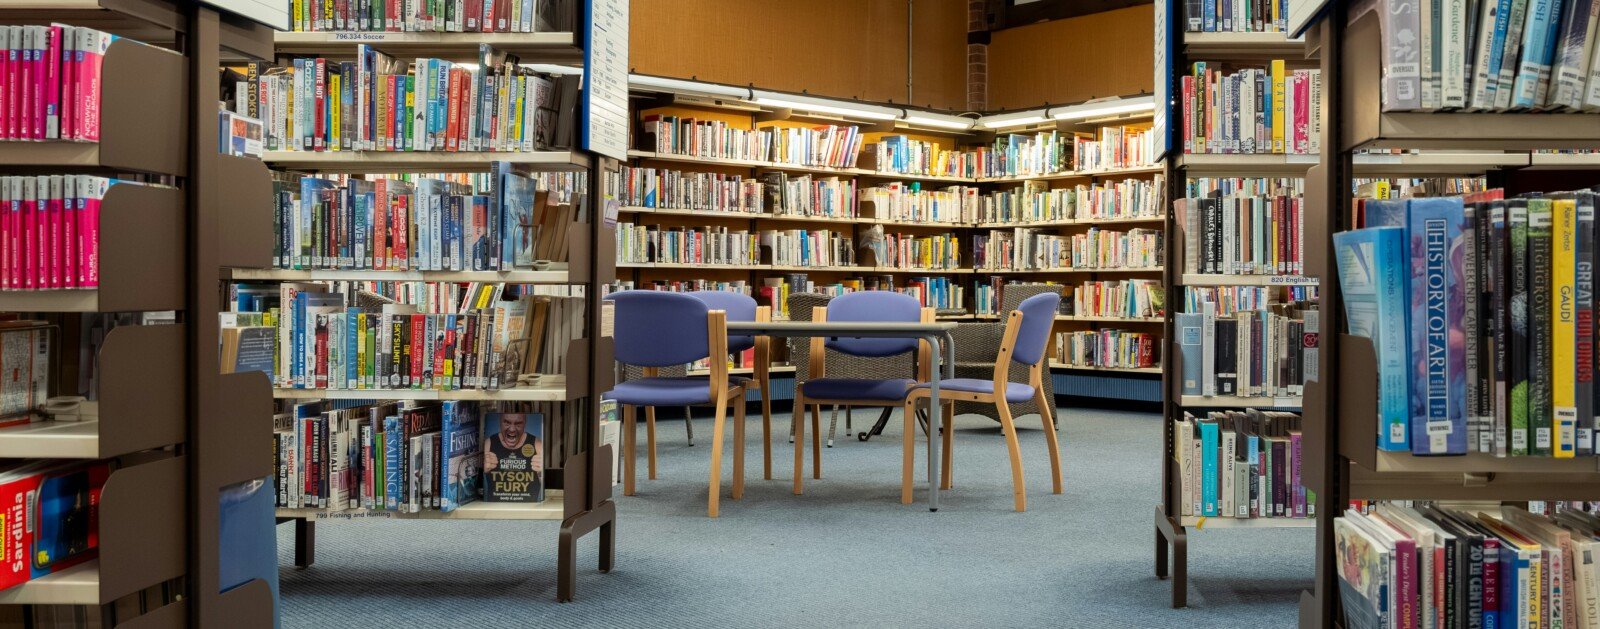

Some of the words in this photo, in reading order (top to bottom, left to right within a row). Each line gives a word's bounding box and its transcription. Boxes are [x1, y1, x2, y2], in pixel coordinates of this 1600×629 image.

[1485, 31, 1493, 52] PADDY
[248, 63, 257, 81] BEN
[316, 63, 324, 84] WHITE
[248, 84, 257, 119] STOKES
[316, 85, 324, 99] HOT
[438, 80, 446, 106] BRITAIN
[420, 217, 426, 226] K2
[1285, 276, 1309, 284] English
[1428, 232, 1444, 314] HISTORY
[1466, 252, 1475, 304] WEEKEND
[1535, 238, 1545, 321] HIGHGROVE
[1577, 261, 1592, 307] GREAT
[1429, 315, 1445, 341] OF
[1466, 308, 1477, 370] CARPENTER
[1577, 309, 1592, 383] BUILDINGS
[1429, 343, 1445, 378] ART
[387, 439, 397, 492] SAILING
[490, 471, 534, 482] TYSON
[495, 481, 530, 492] FURY
[329, 512, 351, 520] Fishing
[366, 511, 391, 519] Hunting
[12, 492, 23, 573] Sardinia
[1402, 552, 1410, 579] Reader's
[1485, 543, 1495, 603] MLER'S
[1402, 581, 1410, 602] Digest
[1530, 562, 1538, 601] ENTURY
[1530, 604, 1538, 616] OF
